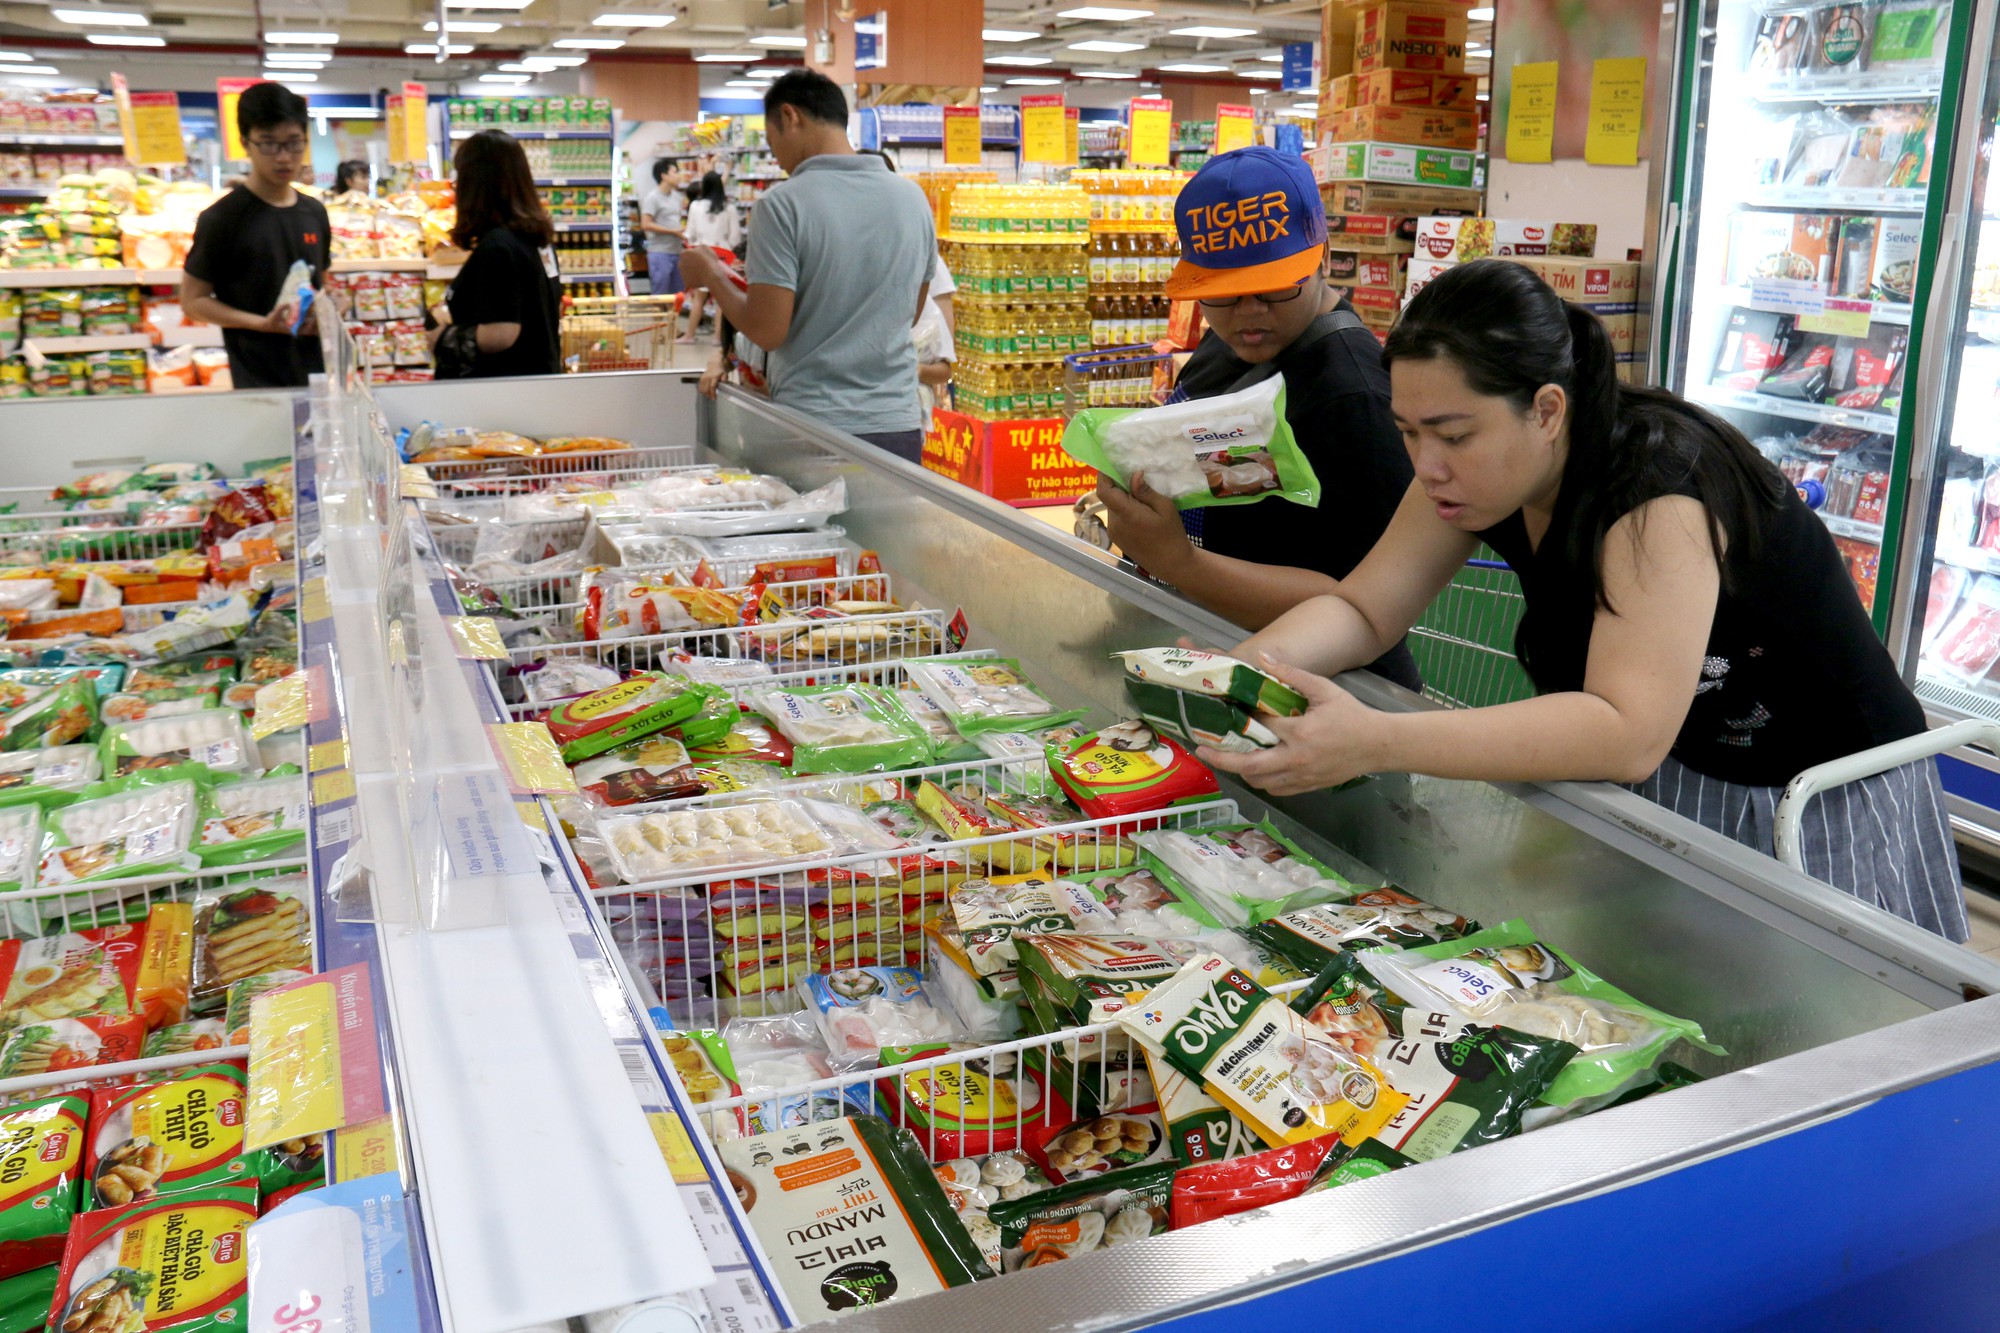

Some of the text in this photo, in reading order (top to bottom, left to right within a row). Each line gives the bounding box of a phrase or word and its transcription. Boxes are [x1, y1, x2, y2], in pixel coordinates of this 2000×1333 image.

[1186, 190, 1290, 232] TIGER
[1190, 214, 1290, 254] REMIX
[1885, 231, 1918, 244] Selec
[1553, 269, 1575, 290] TÍM
[1586, 283, 1608, 292] VIFON
[1009, 424, 1064, 451] TỰ HÀ
[1192, 428, 1247, 443] Select
[1027, 473, 1098, 491] Tự hào tạo khá
[942, 668, 965, 688] Select
[780, 694, 805, 721] Select
[1285, 913, 1331, 940] MANDU
[1120, 963, 1144, 972] EGG
[1448, 966, 1494, 996] Select
[338, 973, 364, 1030] Khuyến mãi
[1146, 1018, 1155, 1026] CJ
[1175, 979, 1249, 1055] OhYa
[1217, 1057, 1235, 1077] HÁ
[1238, 1066, 1251, 1080] MỎNG
[161, 1104, 187, 1143] THỊT
[187, 1089, 215, 1150] CHẢ GIÒ
[0, 1156, 28, 1184] GIÒ
[836, 1178, 871, 1197] 만두
[1152, 1193, 1167, 1206] 06
[815, 1189, 879, 1218] THỊT MEAT
[1049, 1206, 1075, 1218] LƯỢNG
[1074, 1203, 1091, 1214] KHỐI
[786, 1203, 887, 1246] MANDU
[1014, 1216, 1028, 1228] 50
[157, 1212, 188, 1313] ĐẶC BIỆT HẢI SẢN
[182, 1229, 208, 1281] CHẢ GIÒ
[794, 1235, 888, 1270] 비비고
[829, 1273, 887, 1294] bibigo
